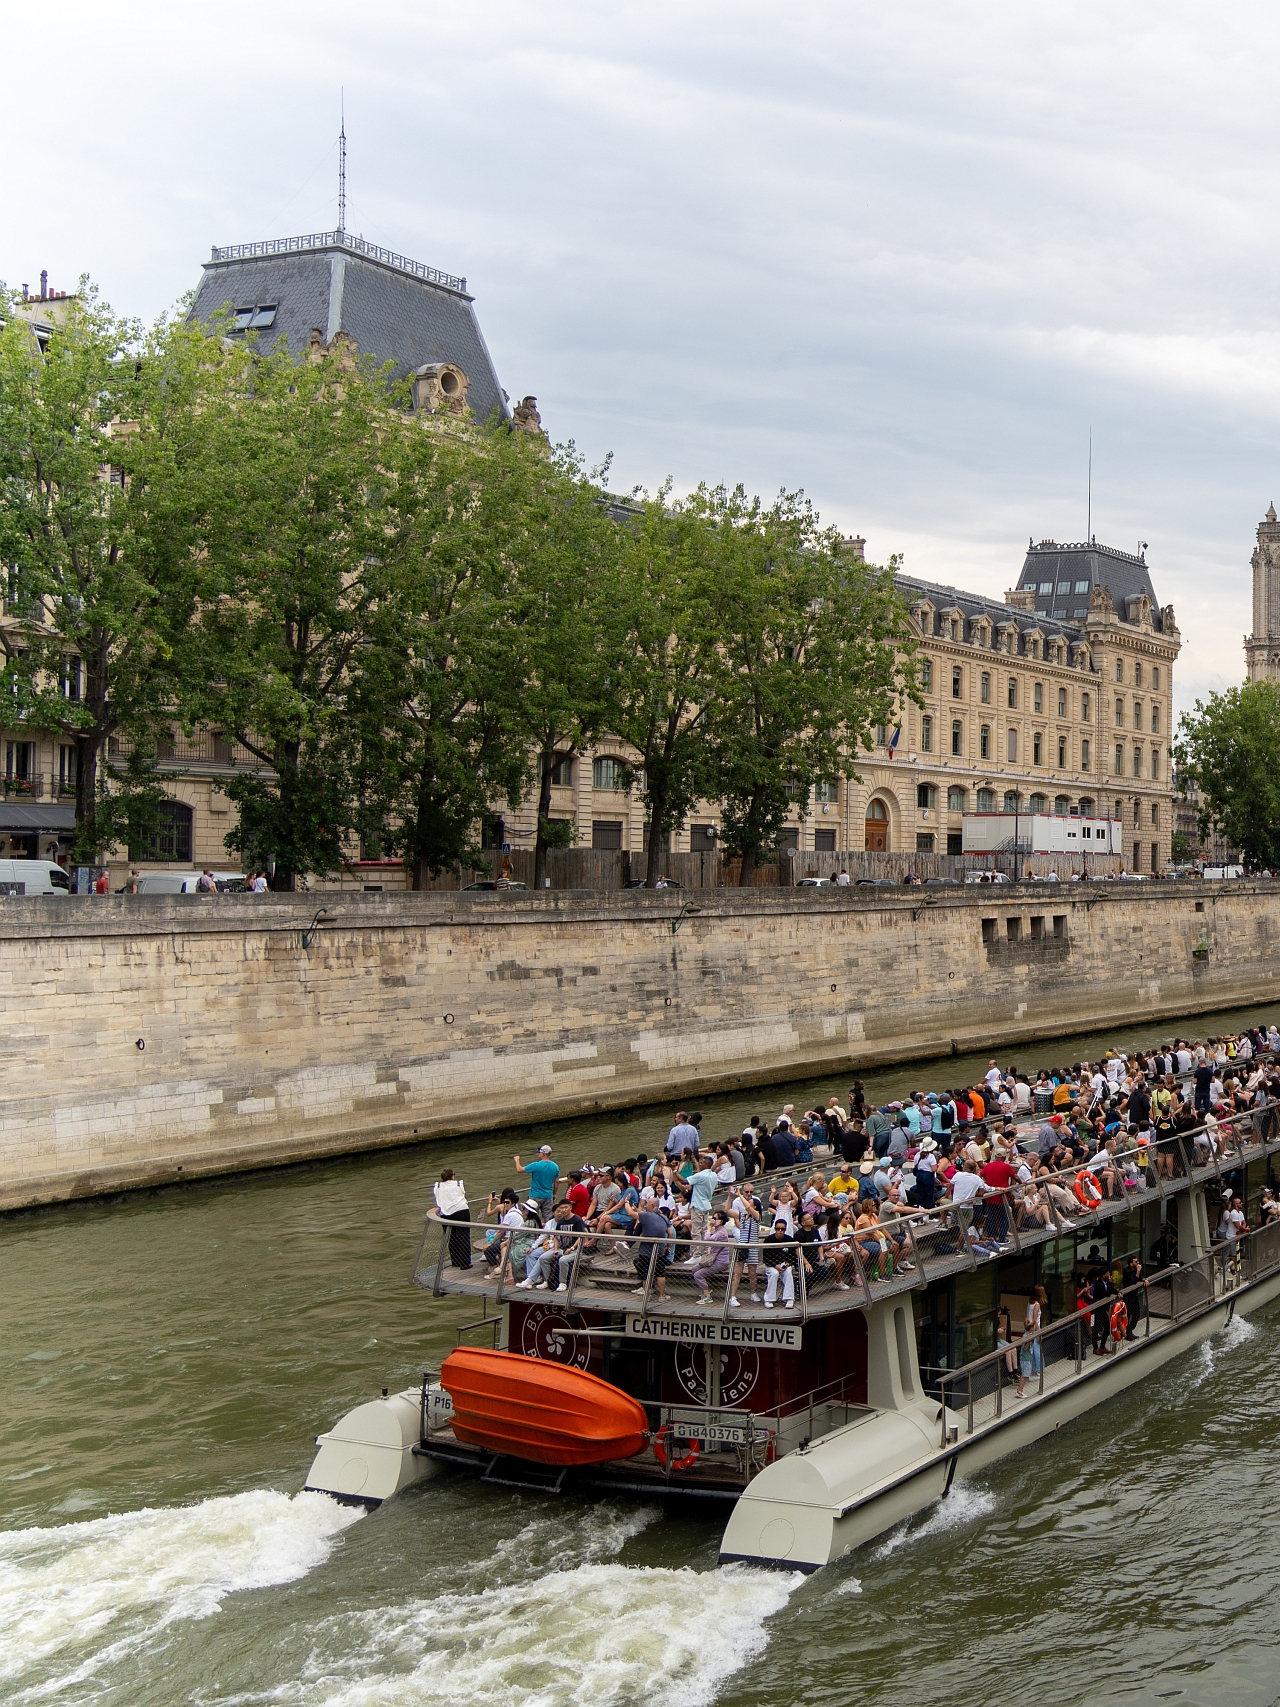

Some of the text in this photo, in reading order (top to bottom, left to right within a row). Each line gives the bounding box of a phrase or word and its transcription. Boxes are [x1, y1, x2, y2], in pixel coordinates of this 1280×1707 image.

[632, 1318, 795, 1345] CATHERINE DENEUVE
[678, 1425, 740, 1441] 01840376
